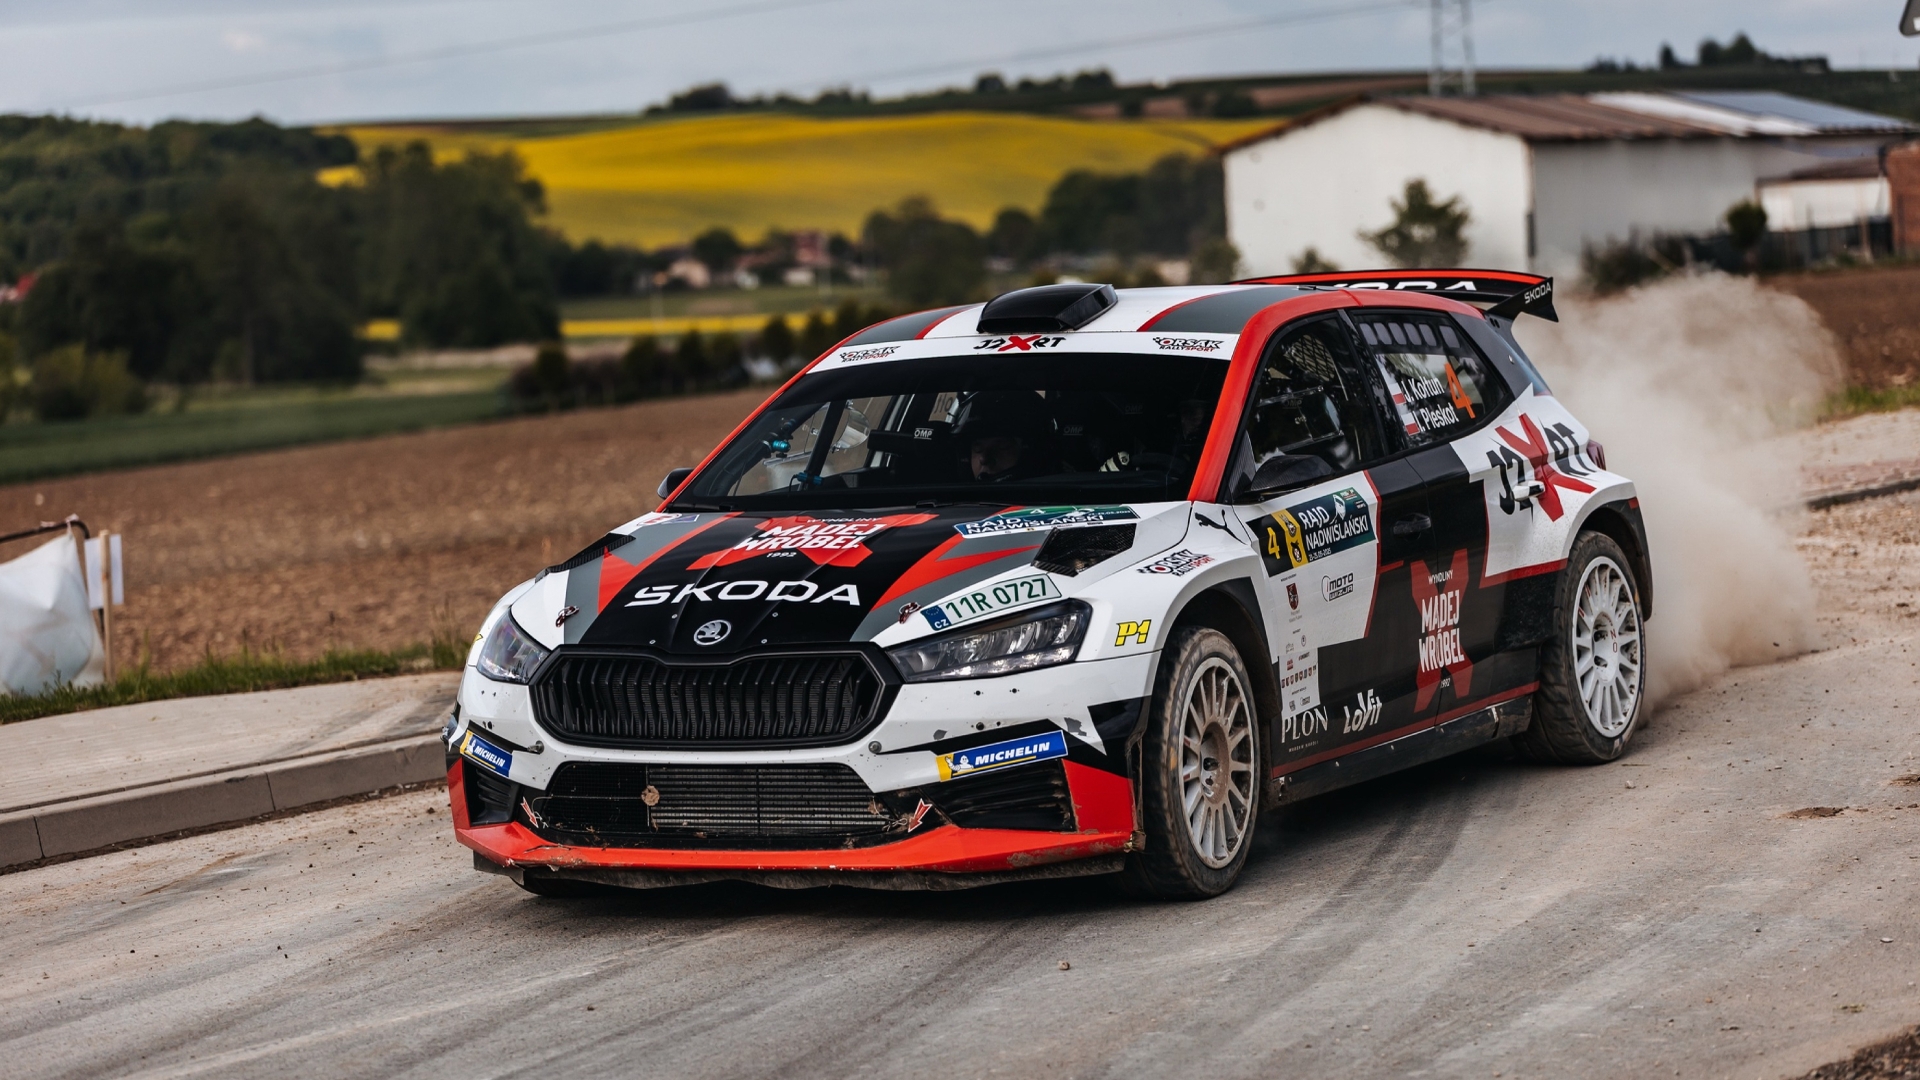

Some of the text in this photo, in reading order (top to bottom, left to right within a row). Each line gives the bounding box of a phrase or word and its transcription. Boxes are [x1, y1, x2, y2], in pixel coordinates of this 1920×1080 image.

[1524, 282, 1551, 304] SKODA
[1156, 338, 1224, 349] ORSAK
[1401, 380, 1414, 402] J.
[1444, 362, 1476, 418] 4
[1420, 402, 1459, 430] Pleskot
[914, 429, 933, 438] OMP
[966, 518, 1021, 529] RAJD
[1298, 506, 1330, 530] RAJD
[758, 524, 888, 538] MADEJ
[1267, 527, 1281, 559] 4
[1305, 515, 1369, 551] NADWIŚLAŃSKI
[625, 580, 861, 607] SKODA
[1329, 572, 1354, 591] MOTO
[934, 578, 1047, 629] CZ 11R 0727
[1421, 589, 1460, 634] MADEJ
[1114, 619, 1152, 647] P1
[1418, 628, 1465, 673] WRÓBEL
[1281, 705, 1328, 744] PLON
[474, 745, 506, 767] MICHELIN
[975, 741, 1050, 765] MICHELIN
